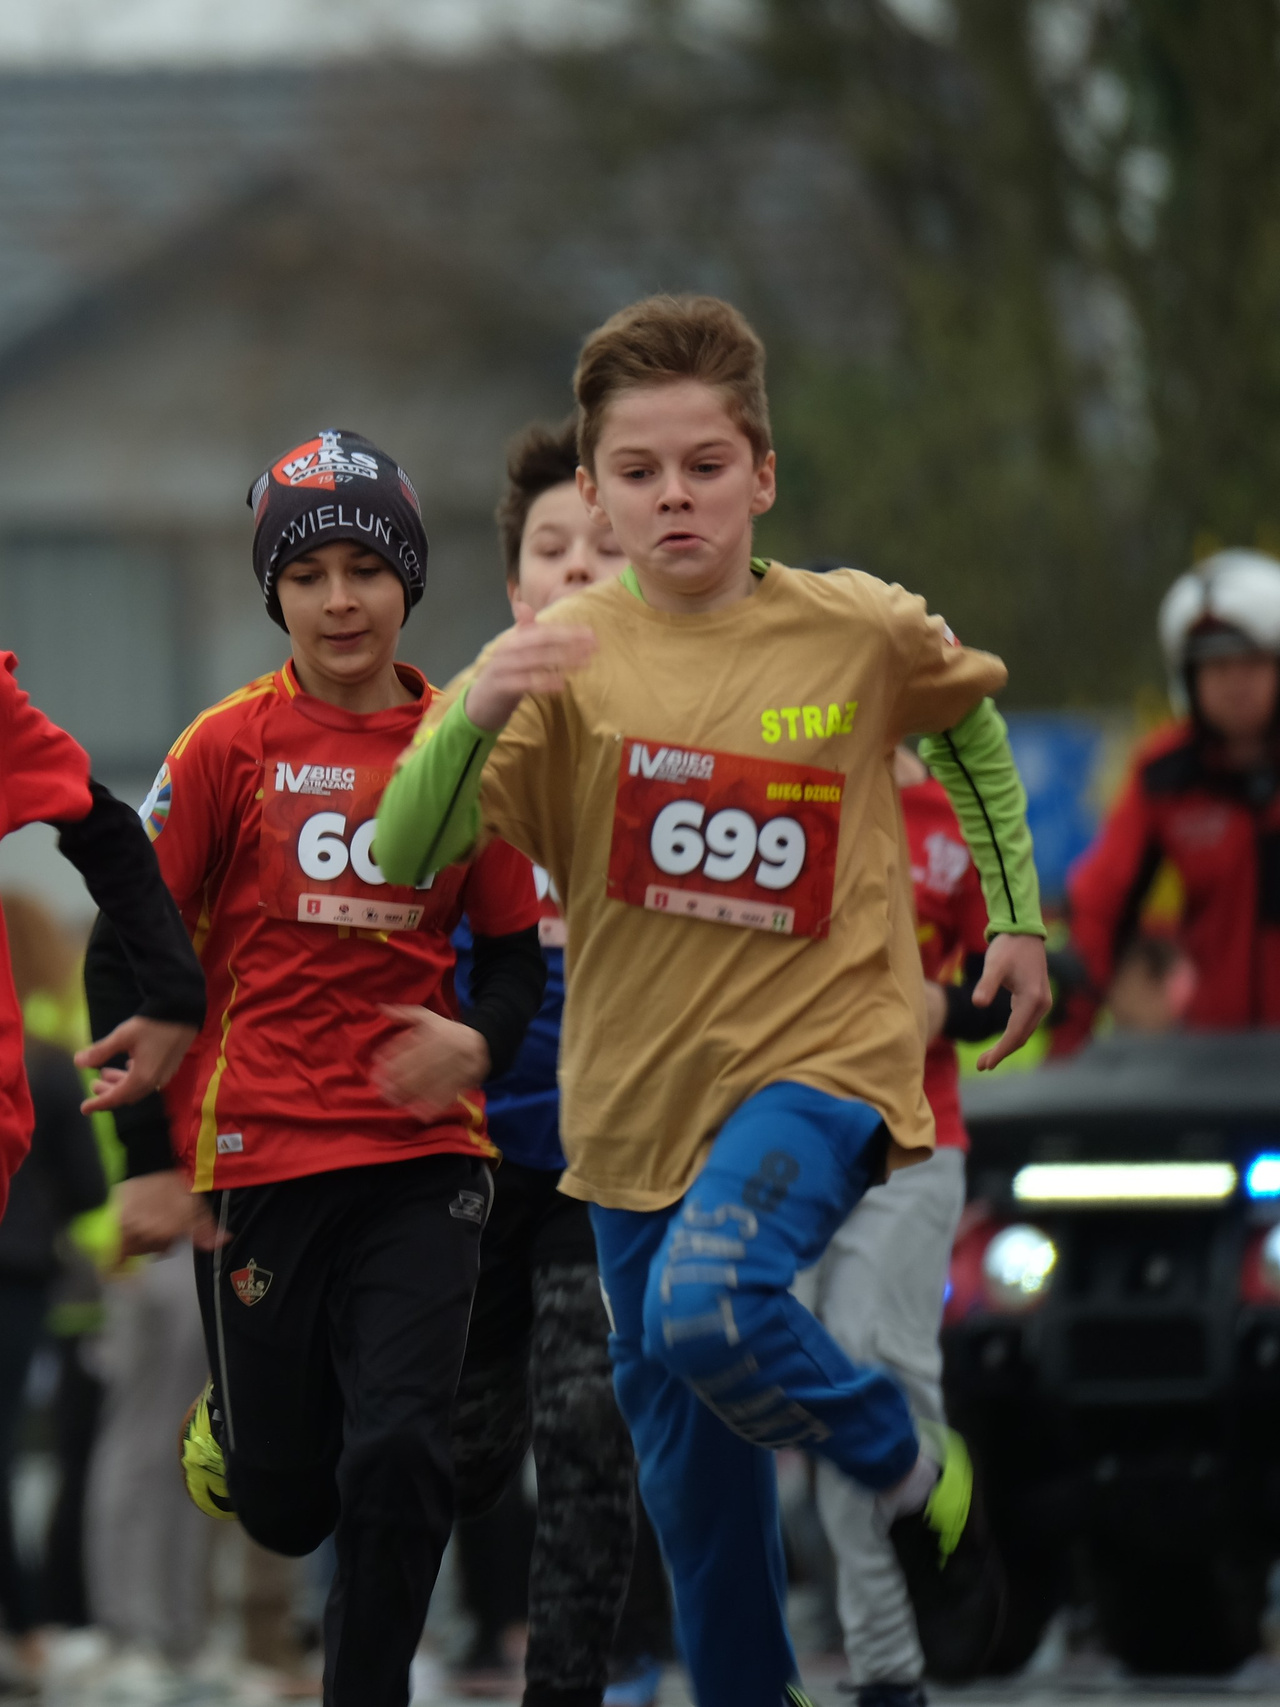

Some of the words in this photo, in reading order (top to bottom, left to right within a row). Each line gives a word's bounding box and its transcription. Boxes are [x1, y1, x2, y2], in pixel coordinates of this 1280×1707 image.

[282, 449, 379, 477] WKS
[317, 475, 354, 484] 1957
[282, 503, 393, 546] WIELUŃ
[275, 762, 312, 793] IV
[313, 766, 355, 783] BIEG
[628, 743, 669, 779] IV
[766, 782, 803, 801] BIEG
[298, 811, 439, 890] 60
[650, 799, 807, 890] 699
